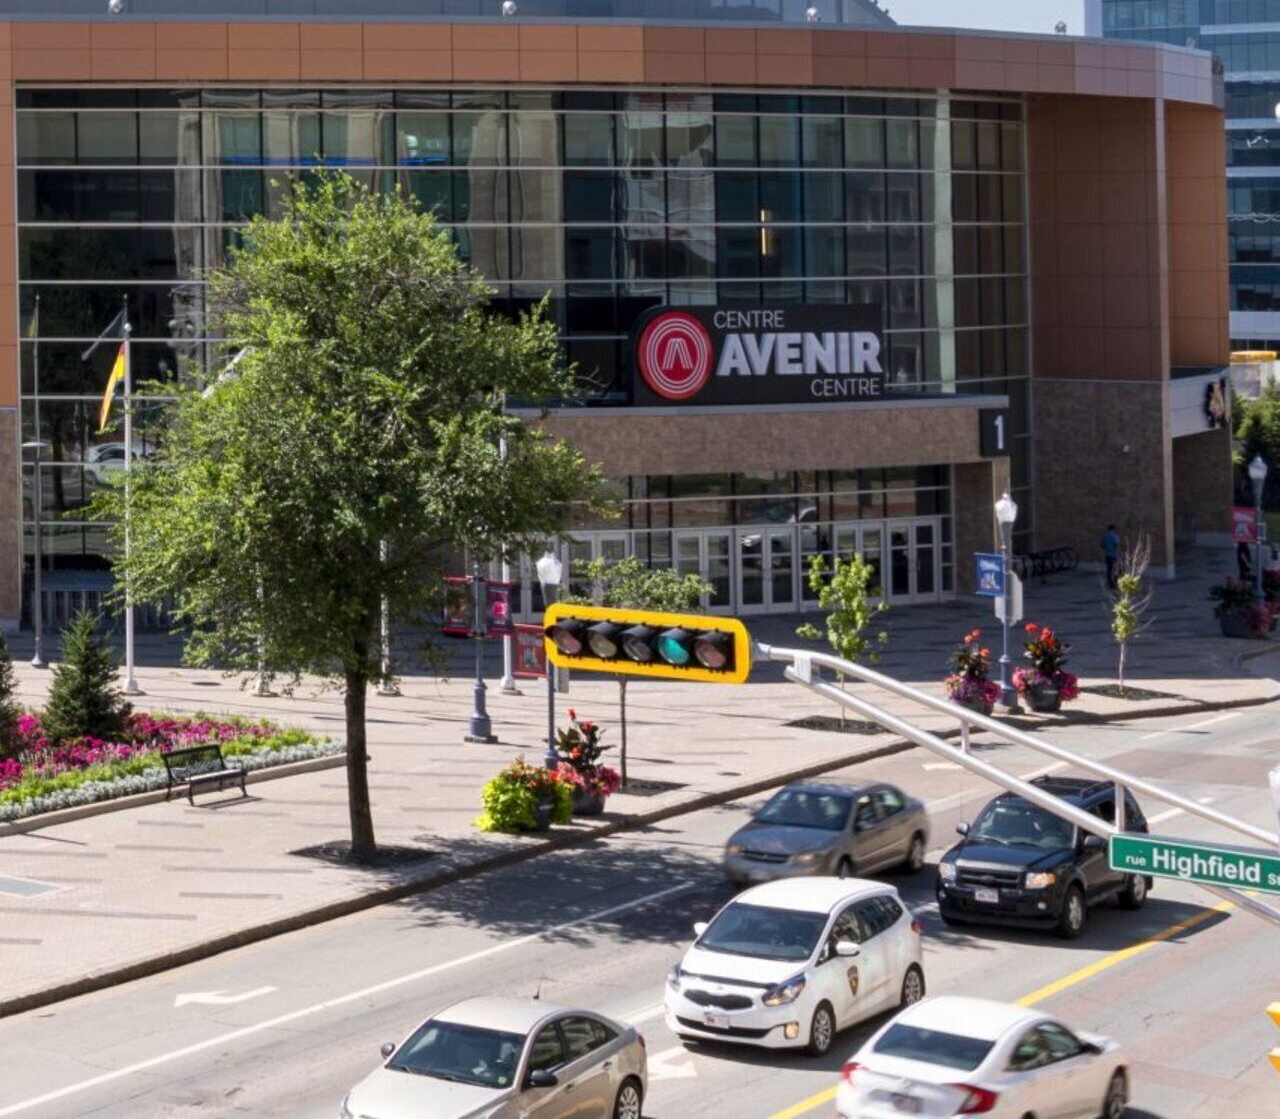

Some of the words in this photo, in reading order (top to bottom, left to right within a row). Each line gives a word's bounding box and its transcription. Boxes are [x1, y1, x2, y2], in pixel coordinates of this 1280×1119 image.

[713, 309, 786, 329] CENTRE
[715, 331, 884, 377] AVENIR
[810, 377, 881, 398] CENTRE
[994, 413, 1005, 451] 1
[1125, 853, 1147, 867] rue
[1152, 847, 1261, 884] Highfield
